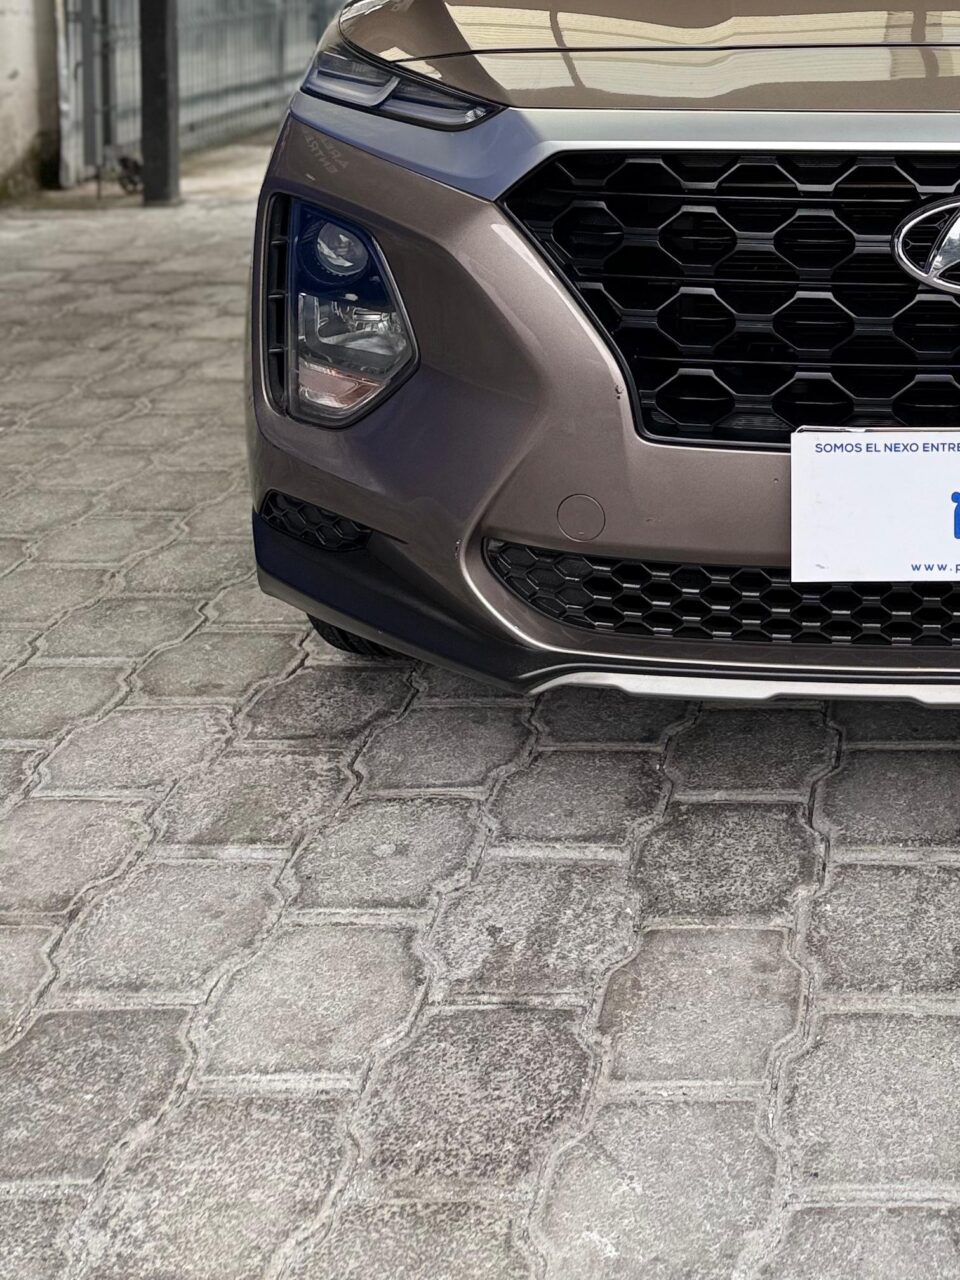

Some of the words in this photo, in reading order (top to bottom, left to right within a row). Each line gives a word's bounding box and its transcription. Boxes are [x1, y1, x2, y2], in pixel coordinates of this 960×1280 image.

[815, 442, 863, 454] SOMOS
[865, 442, 881, 453] EL
[883, 442, 920, 453] NEXO
